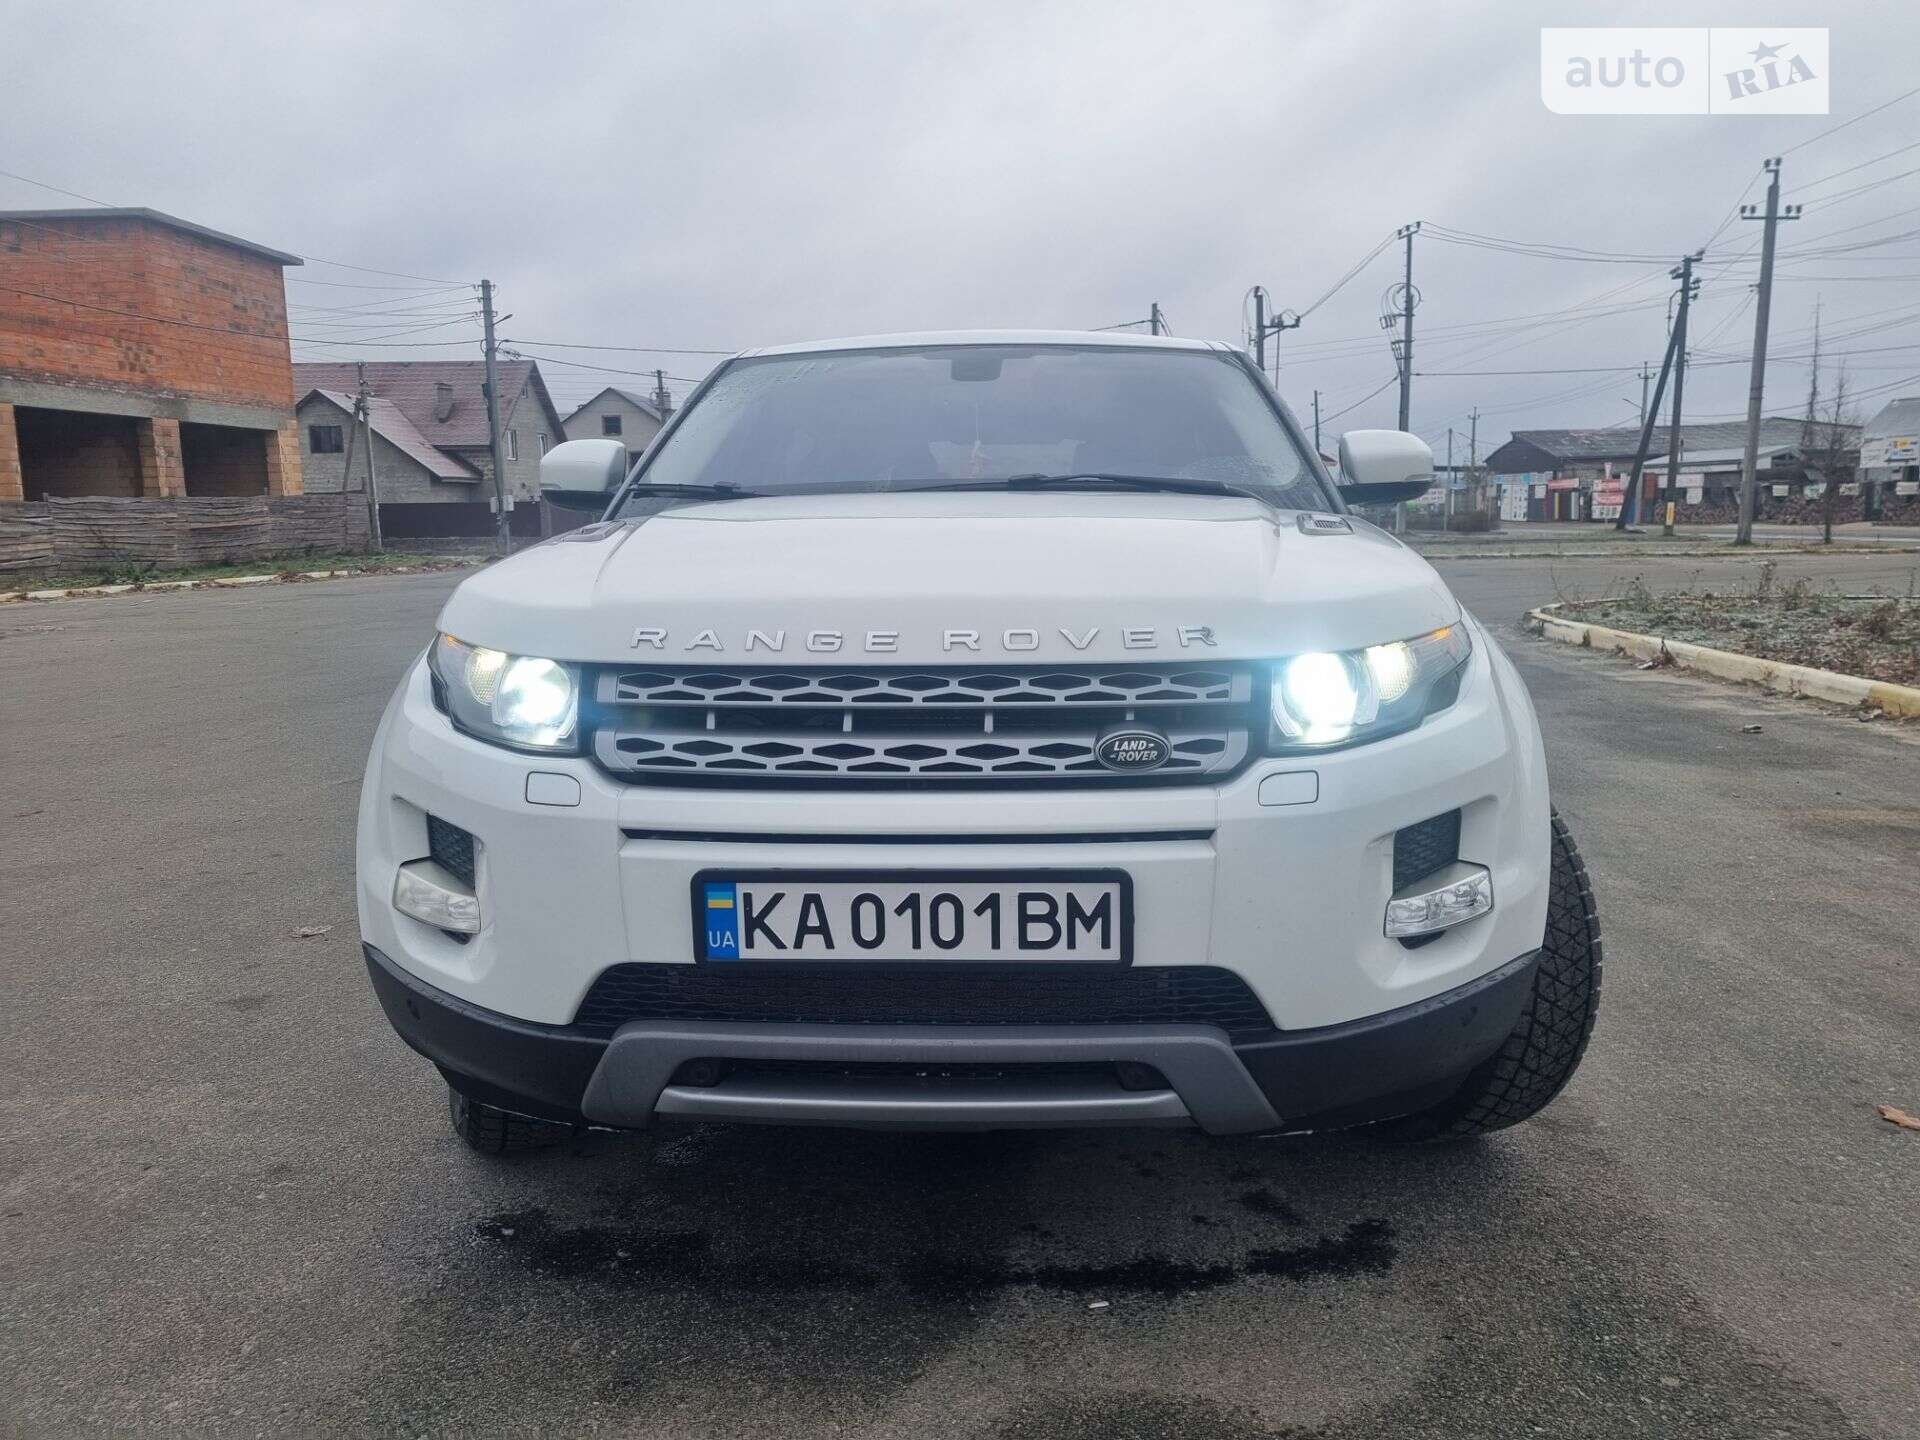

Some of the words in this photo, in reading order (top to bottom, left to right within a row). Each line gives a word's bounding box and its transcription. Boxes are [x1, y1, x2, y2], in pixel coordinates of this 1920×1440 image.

[630, 627, 900, 652] RANGE
[943, 625, 1219, 651] ROVER
[708, 930, 735, 948] UA
